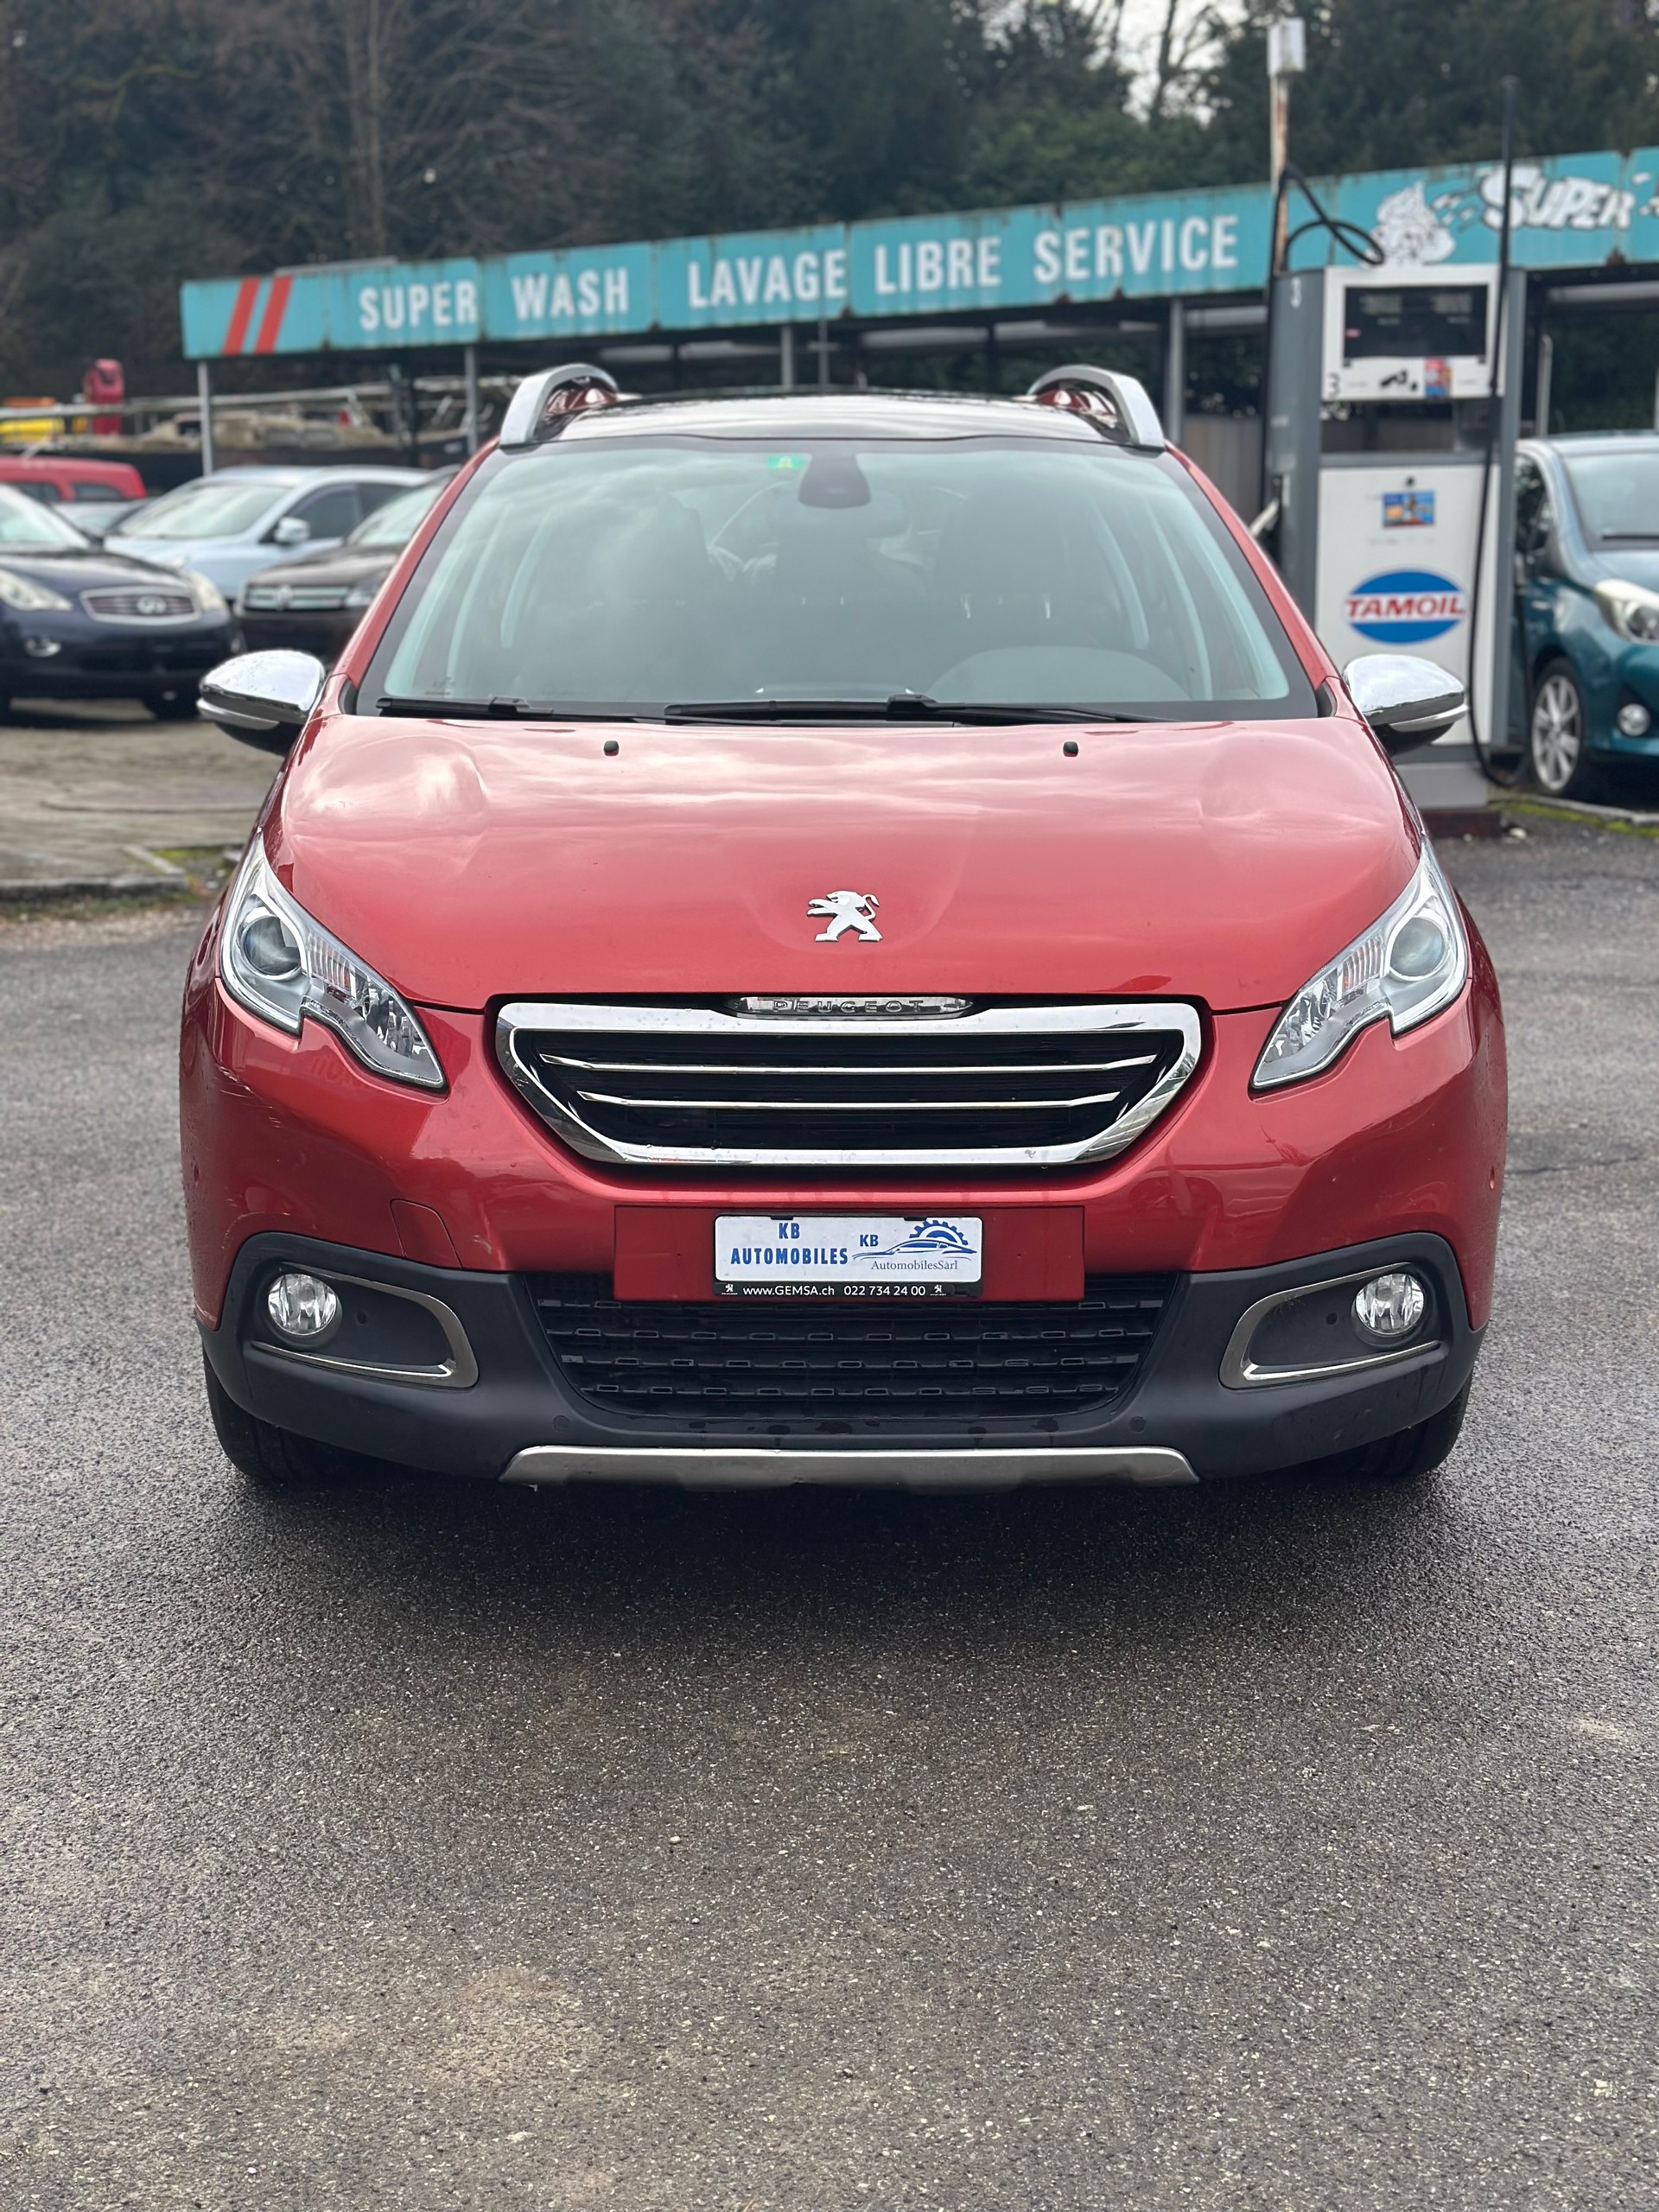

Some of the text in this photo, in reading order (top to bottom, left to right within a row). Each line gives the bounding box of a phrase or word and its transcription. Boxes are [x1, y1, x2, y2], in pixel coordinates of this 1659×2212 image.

[359, 215, 1238, 330] SUPER WASH LAVAGE LIBRE SERVICE
[1346, 597, 1465, 618] TAMOIL
[773, 999, 924, 1013] PEUGEOT
[779, 1223, 800, 1239] KB
[860, 1234, 879, 1247] KB
[730, 1248, 848, 1264] AUTOMOBILES
[743, 1285, 926, 1295] www.GEMSA.ch 022 734 24 00
